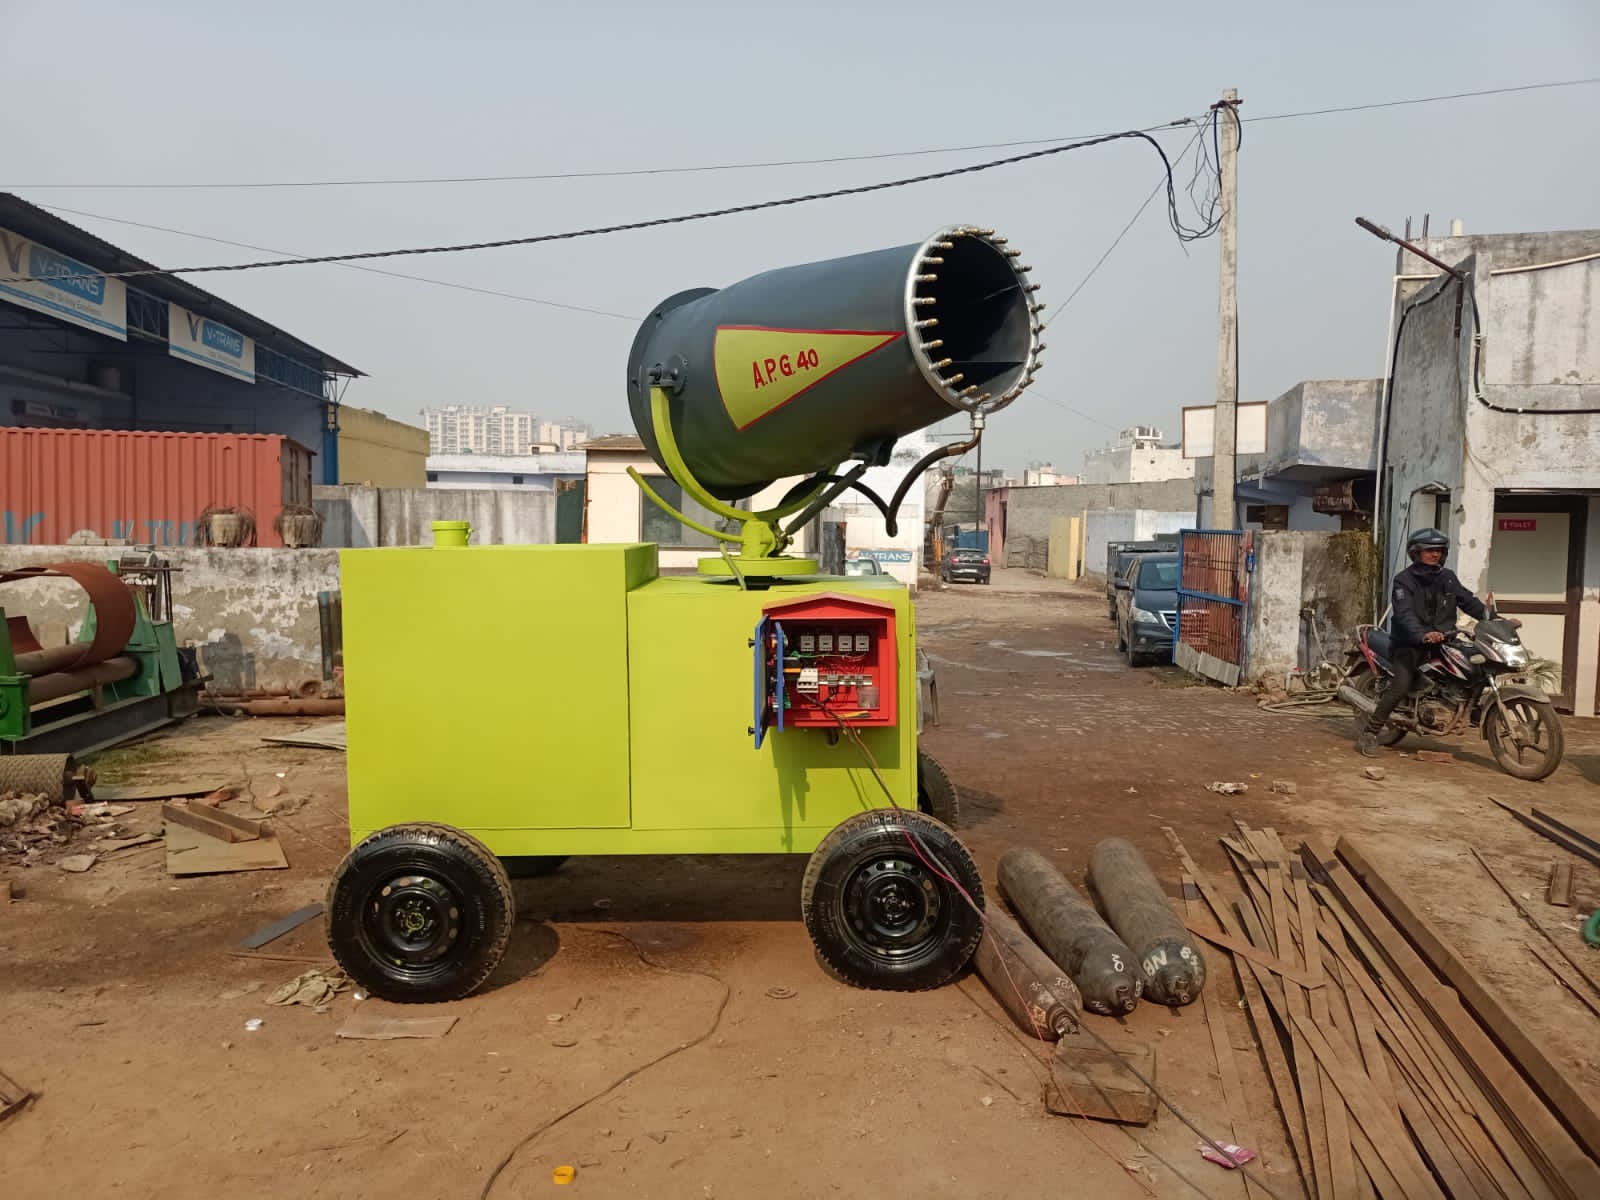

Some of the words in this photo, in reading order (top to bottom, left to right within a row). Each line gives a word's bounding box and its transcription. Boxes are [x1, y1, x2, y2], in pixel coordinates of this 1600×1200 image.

[37, 254, 99, 296] V-TRANS
[206, 327, 241, 353] V-TRANS
[797, 348, 819, 370] 40
